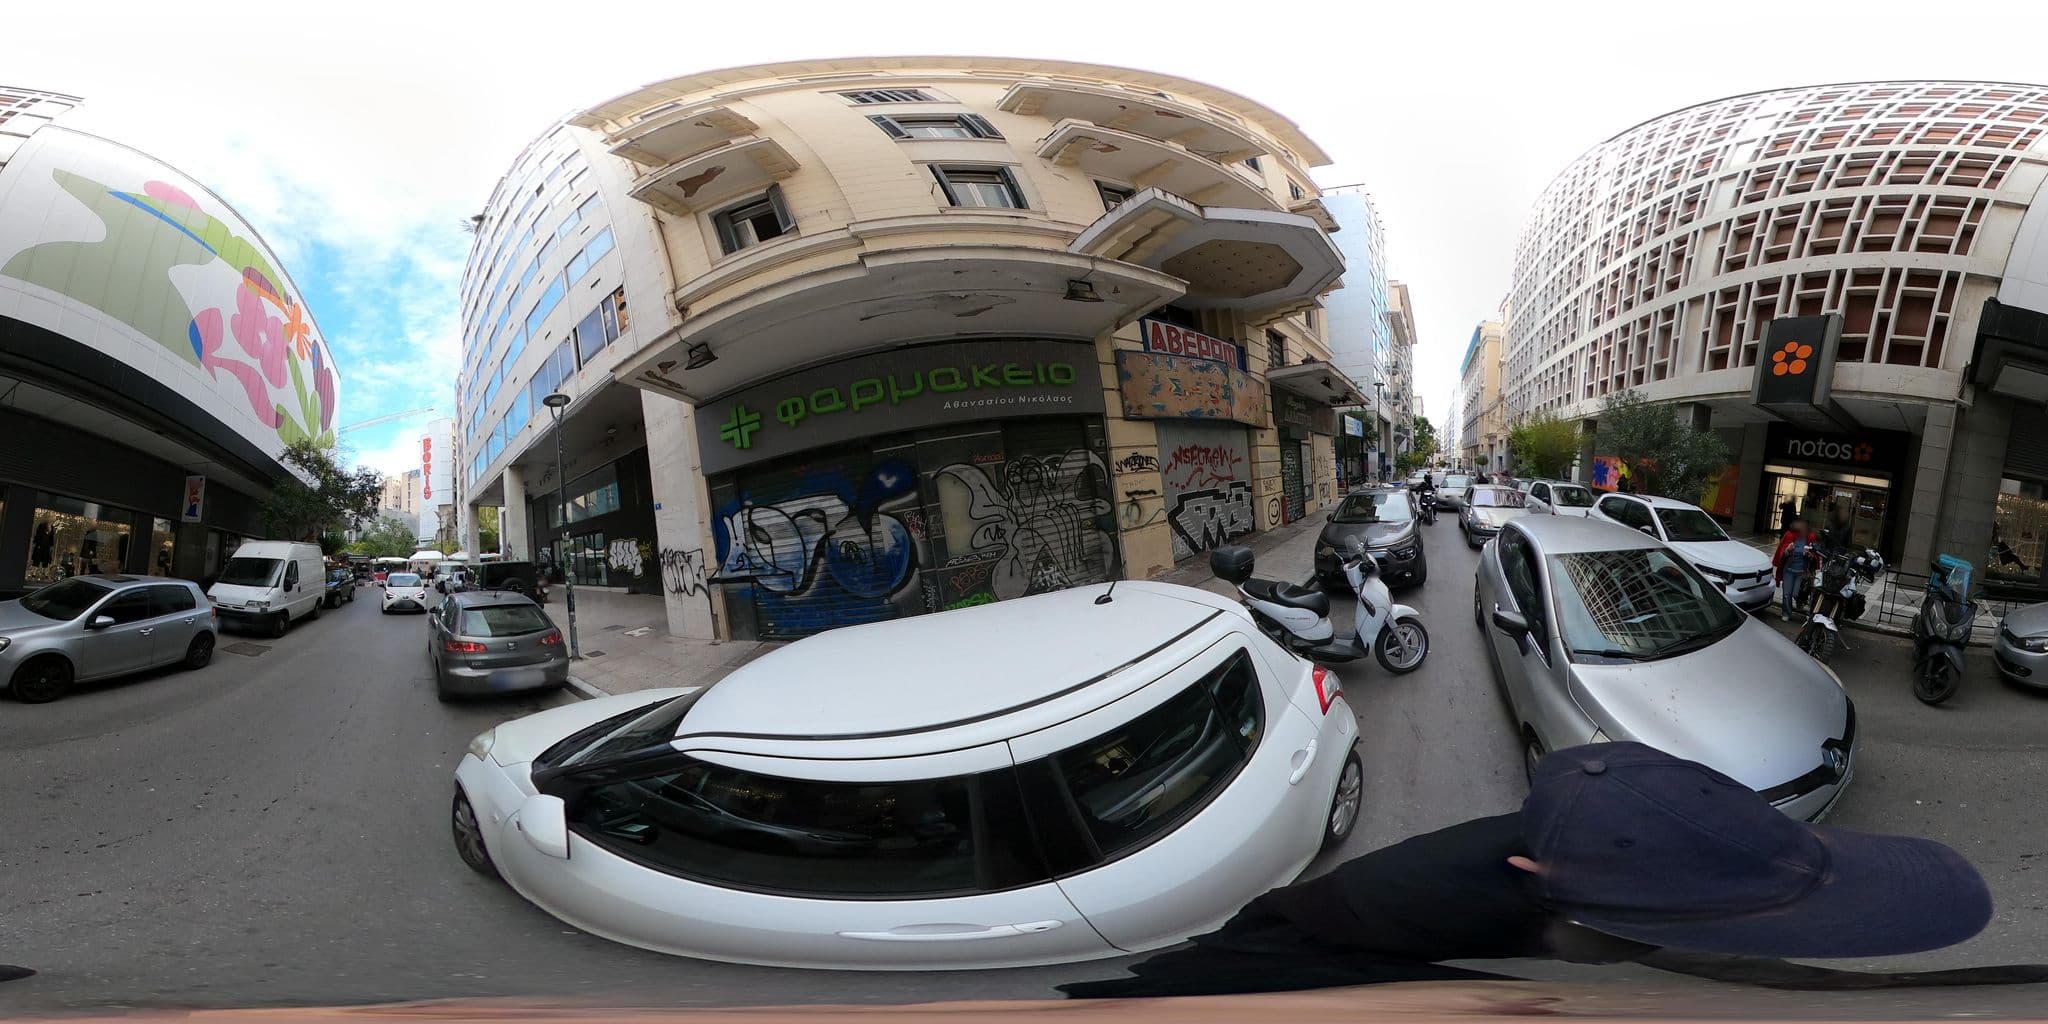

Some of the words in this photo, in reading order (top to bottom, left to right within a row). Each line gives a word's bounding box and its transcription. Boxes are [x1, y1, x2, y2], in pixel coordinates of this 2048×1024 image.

[775, 361, 1078, 427] φαρμακειο
[944, 397, 1014, 409] Αθανασίου
[1019, 394, 1073, 405] Νικόλαος
[1788, 437, 1853, 460] notos
